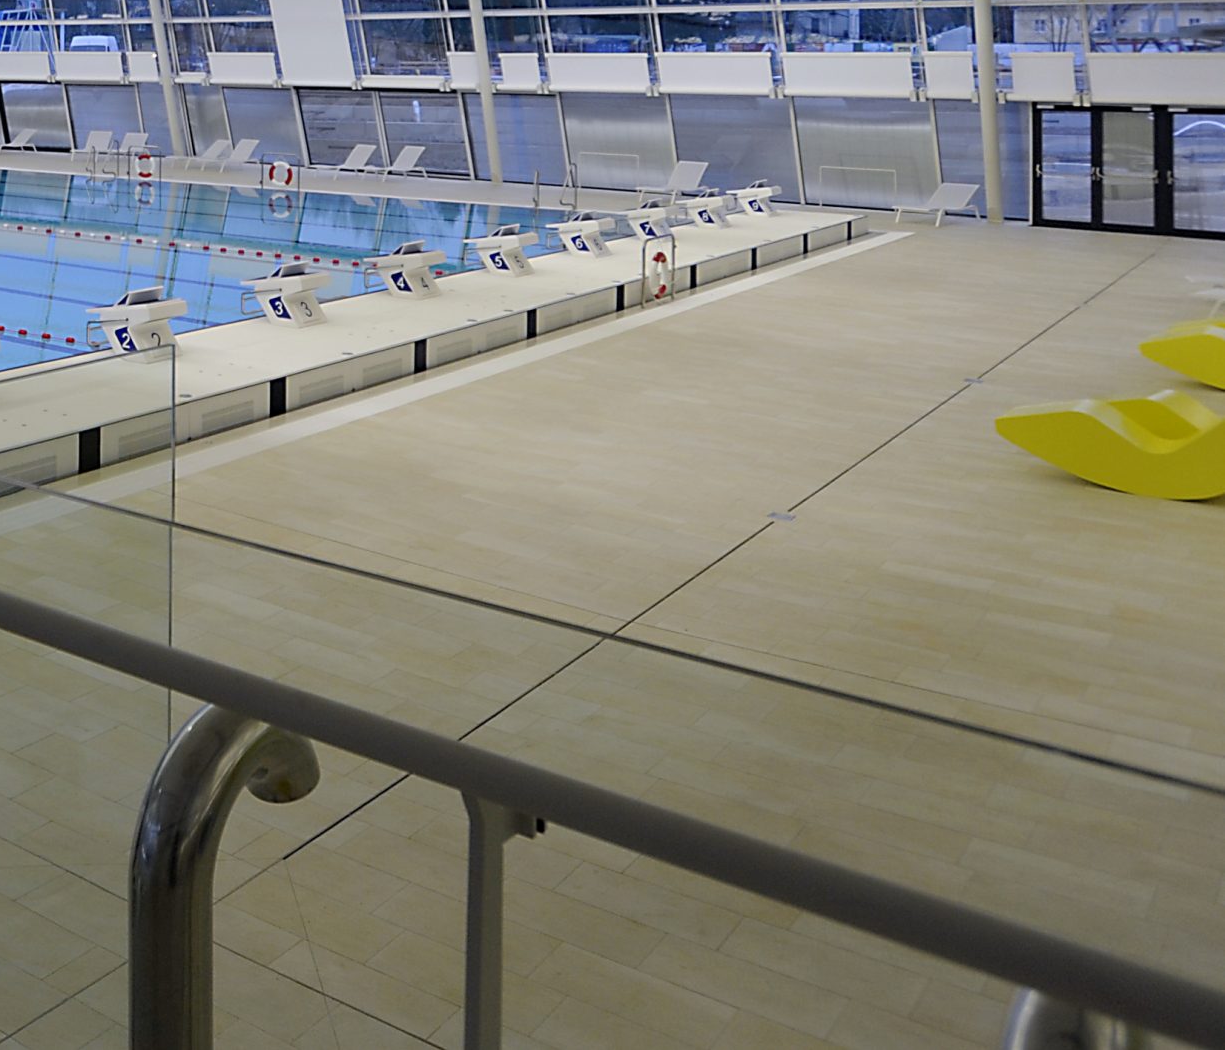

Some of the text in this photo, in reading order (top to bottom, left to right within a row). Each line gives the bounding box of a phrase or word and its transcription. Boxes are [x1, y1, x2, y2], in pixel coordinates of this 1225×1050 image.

[644, 223, 652, 234] 7
[575, 238, 583, 249] 6
[495, 256, 503, 268] 5
[397, 277, 406, 289] 4
[275, 301, 284, 315] 3
[300, 301, 313, 317] 3
[122, 332, 131, 349] 2
